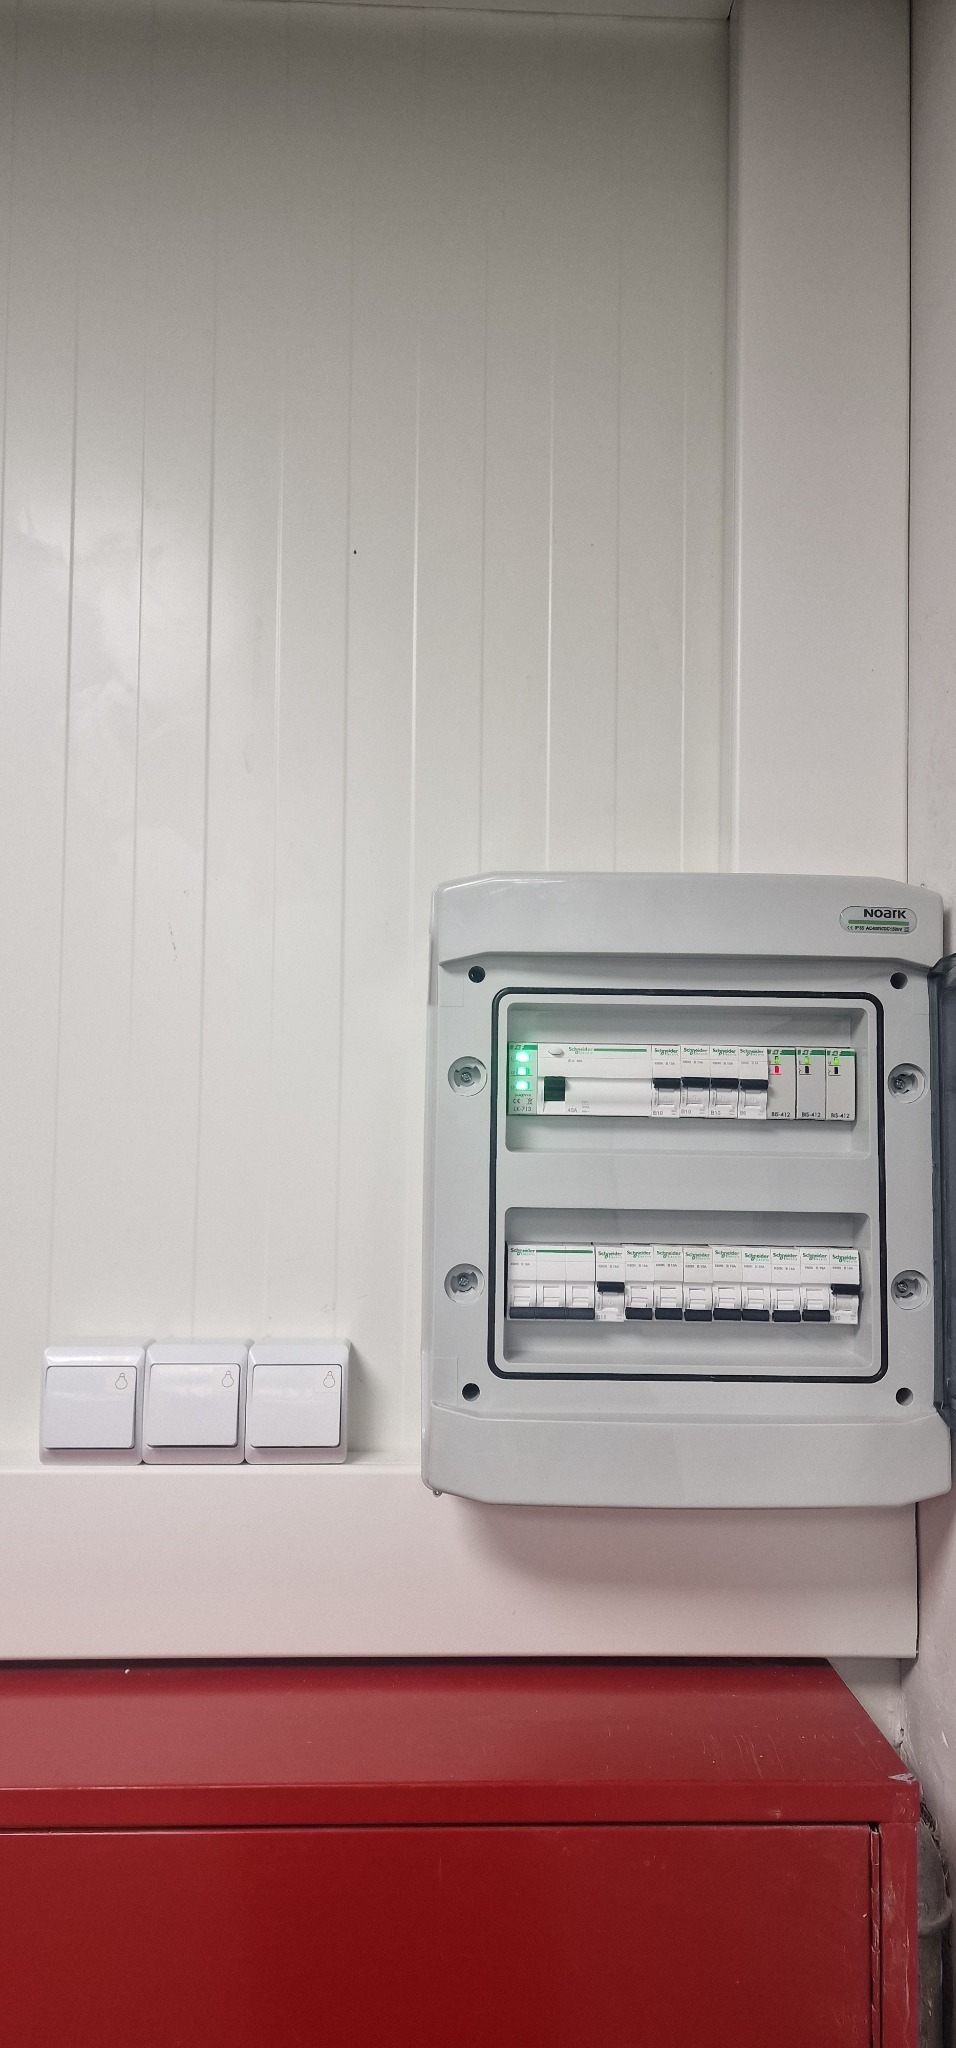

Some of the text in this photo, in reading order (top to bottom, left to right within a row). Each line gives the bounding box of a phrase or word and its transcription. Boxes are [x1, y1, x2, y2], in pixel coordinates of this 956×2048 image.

[598, 1251, 622, 1259] Schneider
[627, 1250, 651, 1258] Schneider
[657, 1250, 681, 1258] Schneider
[685, 1252, 710, 1260] Schneider
[715, 1250, 739, 1258] Schneider
[745, 1253, 769, 1261] Schneider
[773, 1252, 797, 1260] Schneider
[832, 1254, 857, 1262] Schneider
